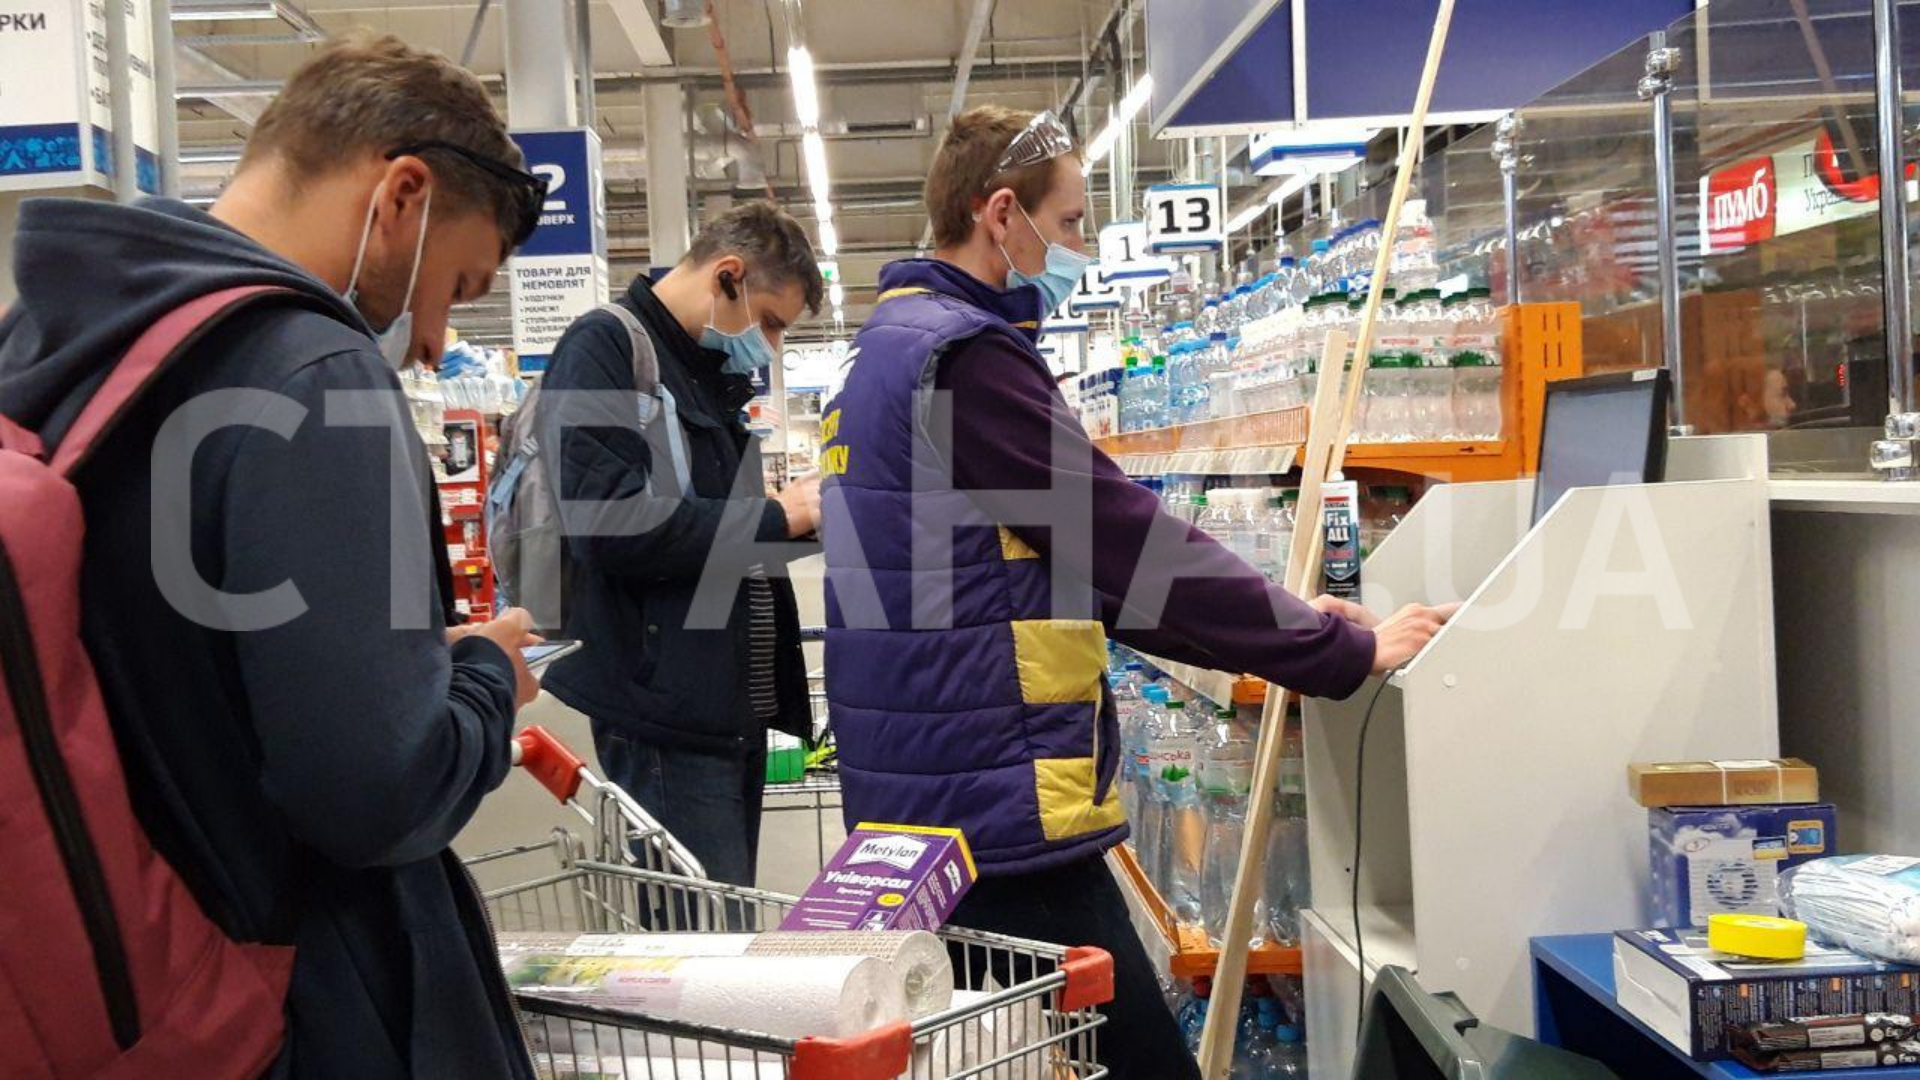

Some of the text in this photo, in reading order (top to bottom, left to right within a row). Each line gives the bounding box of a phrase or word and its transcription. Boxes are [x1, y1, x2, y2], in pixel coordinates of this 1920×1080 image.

[1158, 197, 1212, 234] 13
[516, 266, 592, 279] ТОВАРИ ДЛЯ
[522, 279, 585, 290] НЕМОВЛЯТ
[1326, 512, 1350, 527] Fix
[1327, 527, 1350, 541] ALL
[859, 842, 919, 860] Metylan
[823, 870, 914, 889] Універсал
